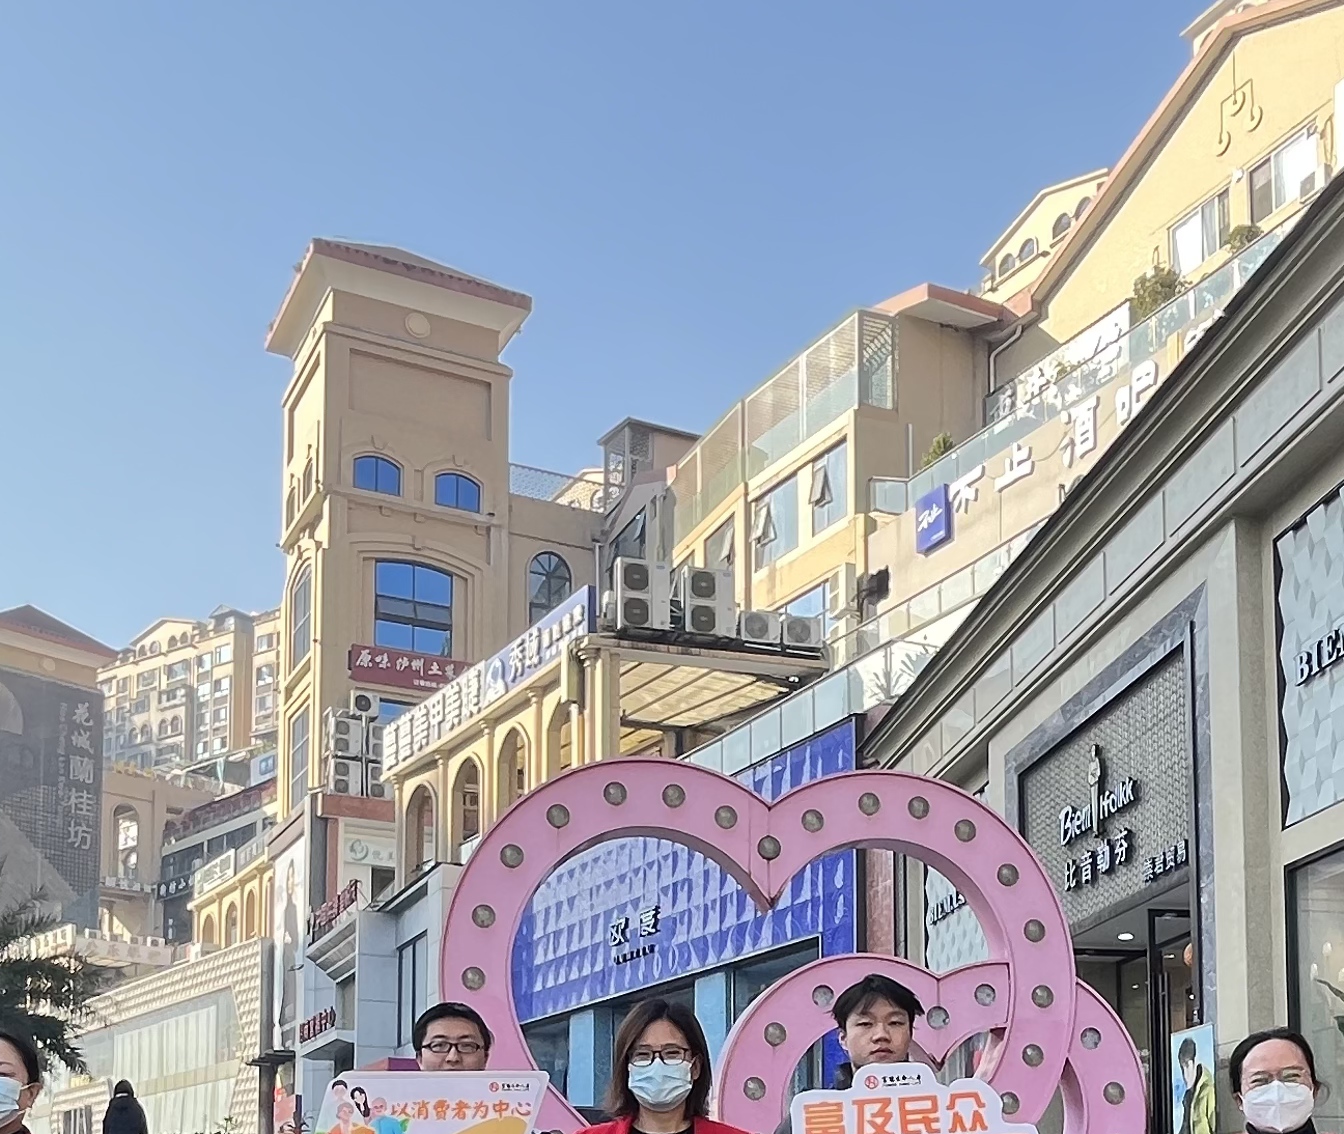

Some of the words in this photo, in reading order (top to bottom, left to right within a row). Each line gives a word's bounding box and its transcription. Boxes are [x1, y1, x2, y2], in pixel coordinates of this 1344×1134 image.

[1064, 828, 1129, 891] 比音勒芬
[390, 1099, 532, 1121] 以消费者为中心
